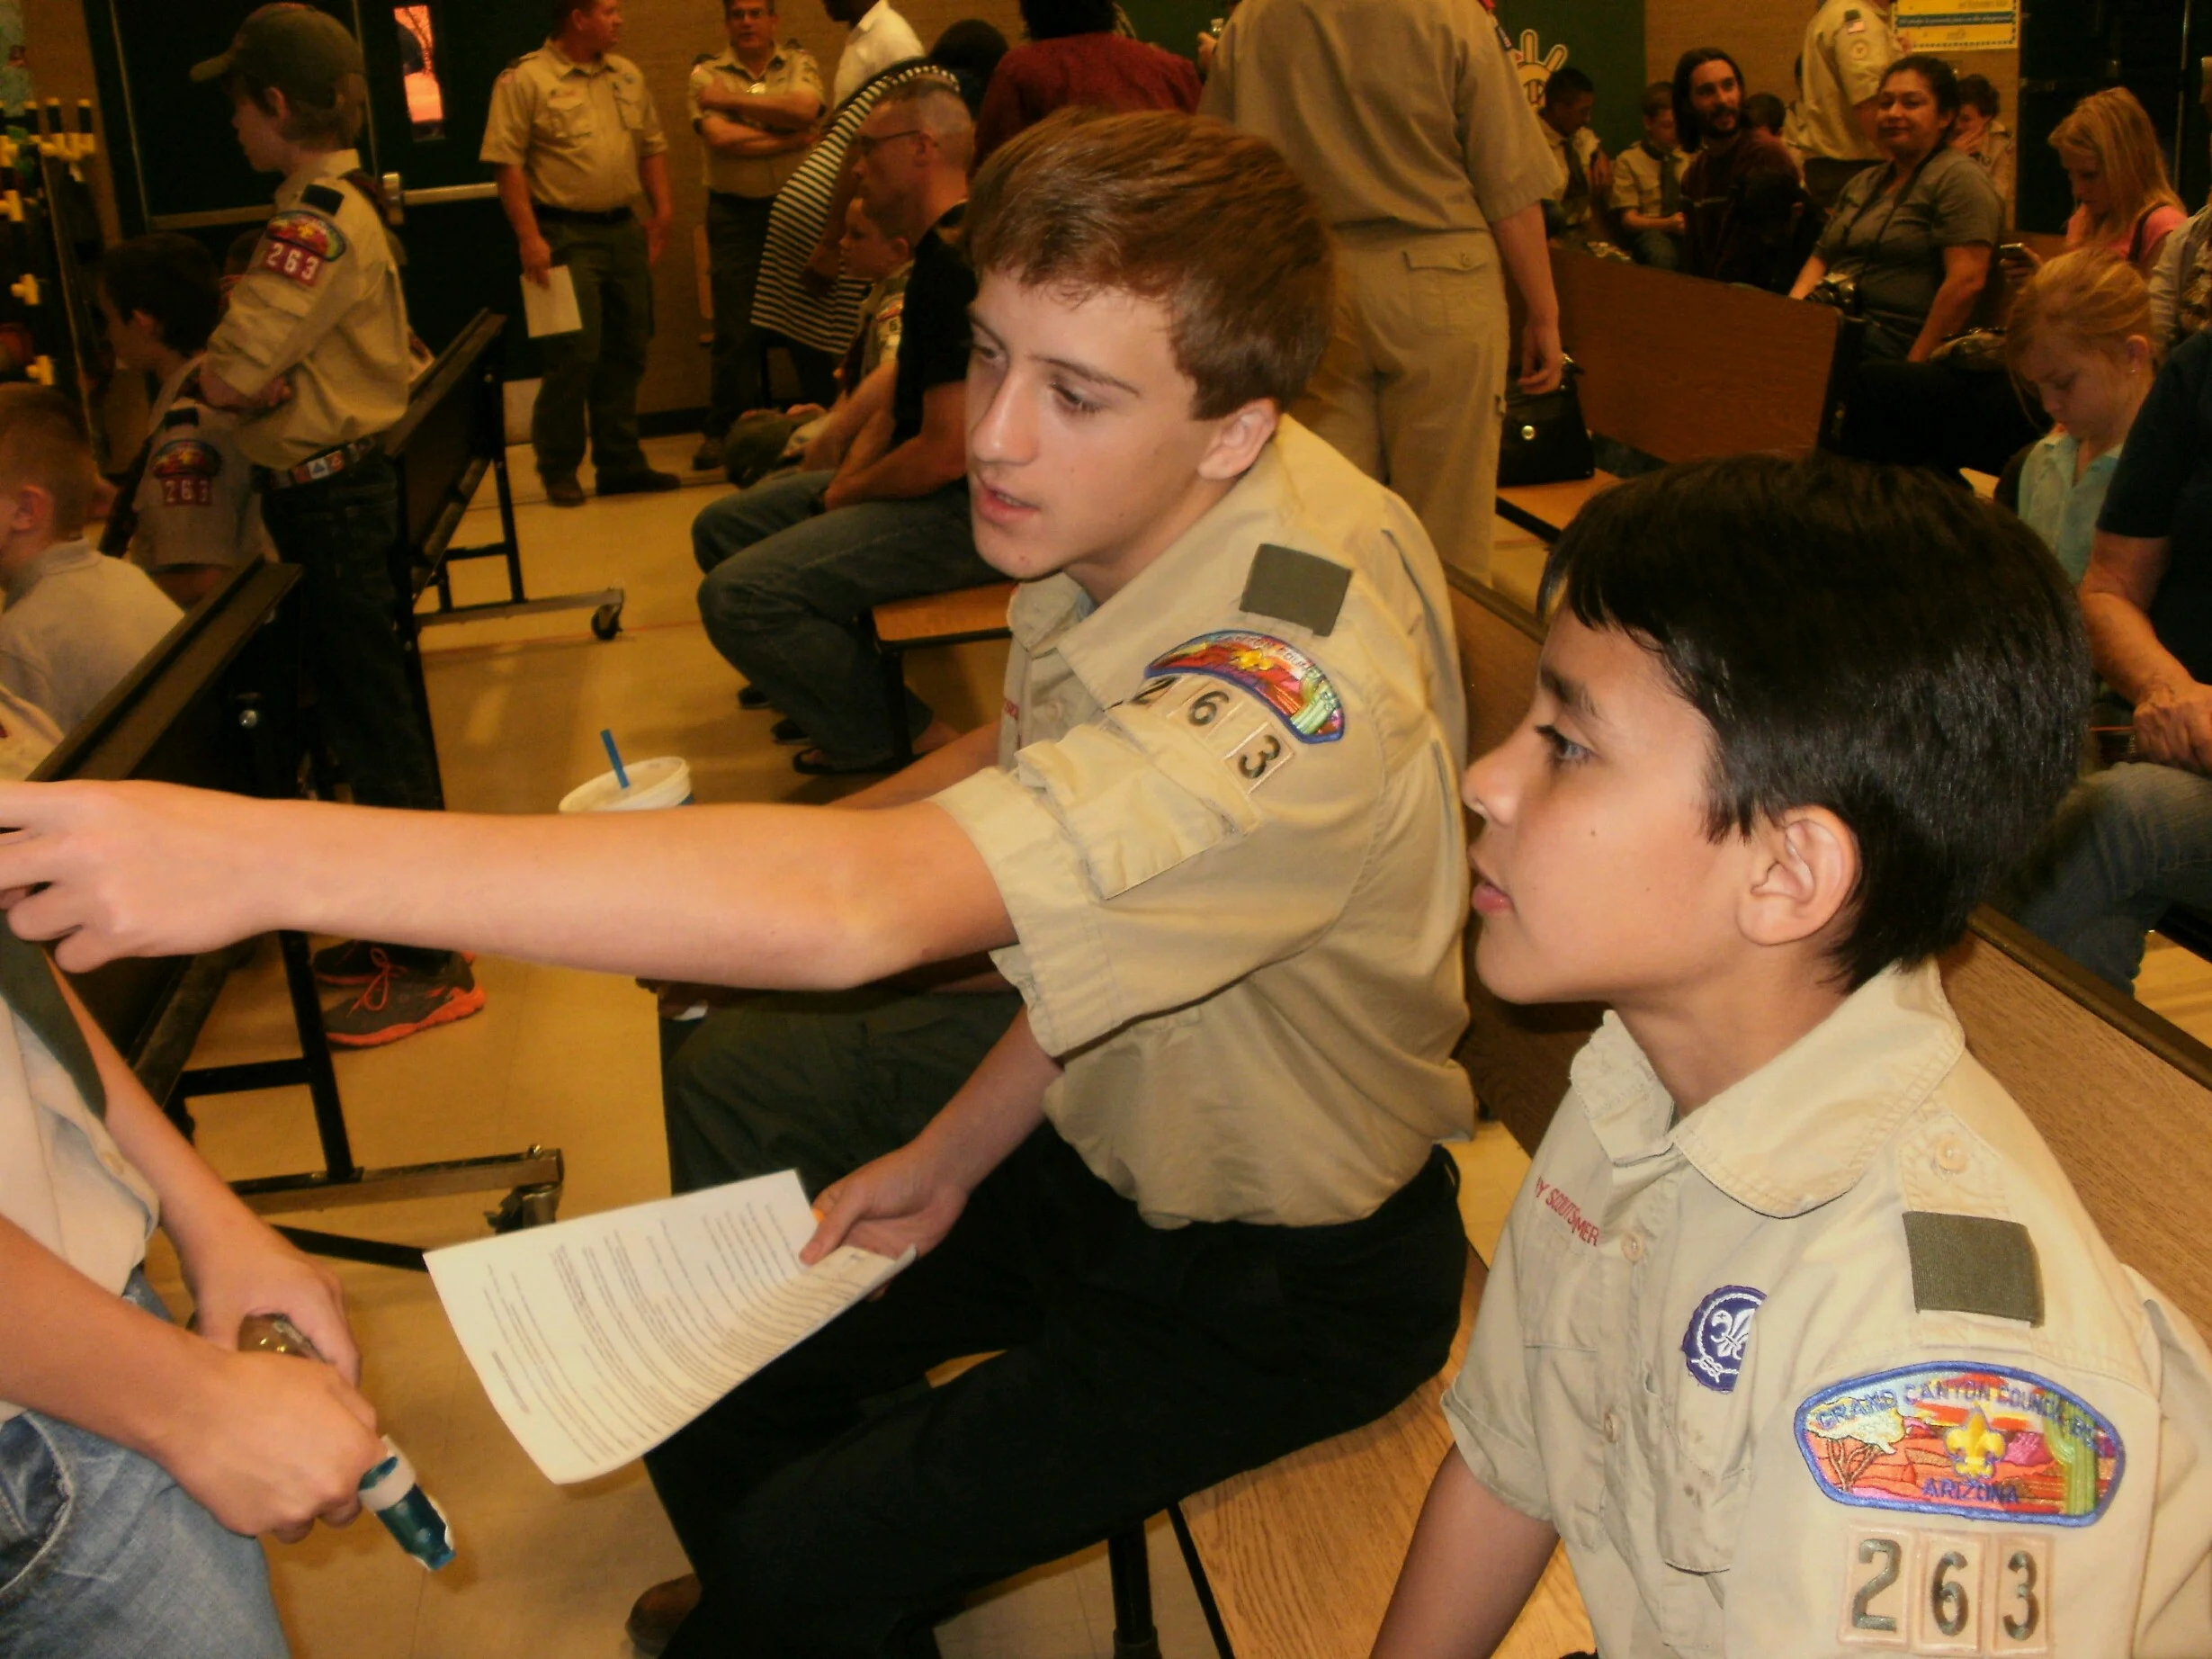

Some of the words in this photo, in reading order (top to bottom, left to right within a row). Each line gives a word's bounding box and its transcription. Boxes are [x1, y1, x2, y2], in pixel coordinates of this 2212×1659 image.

[267, 243, 318, 280] 263
[166, 479, 209, 502] 263
[1816, 1389, 1898, 1430] GRAND
[1903, 1379, 1991, 1405] CANYON
[1922, 1477, 2019, 1503] ARIZONA
[1851, 1538, 2040, 1641] 263
